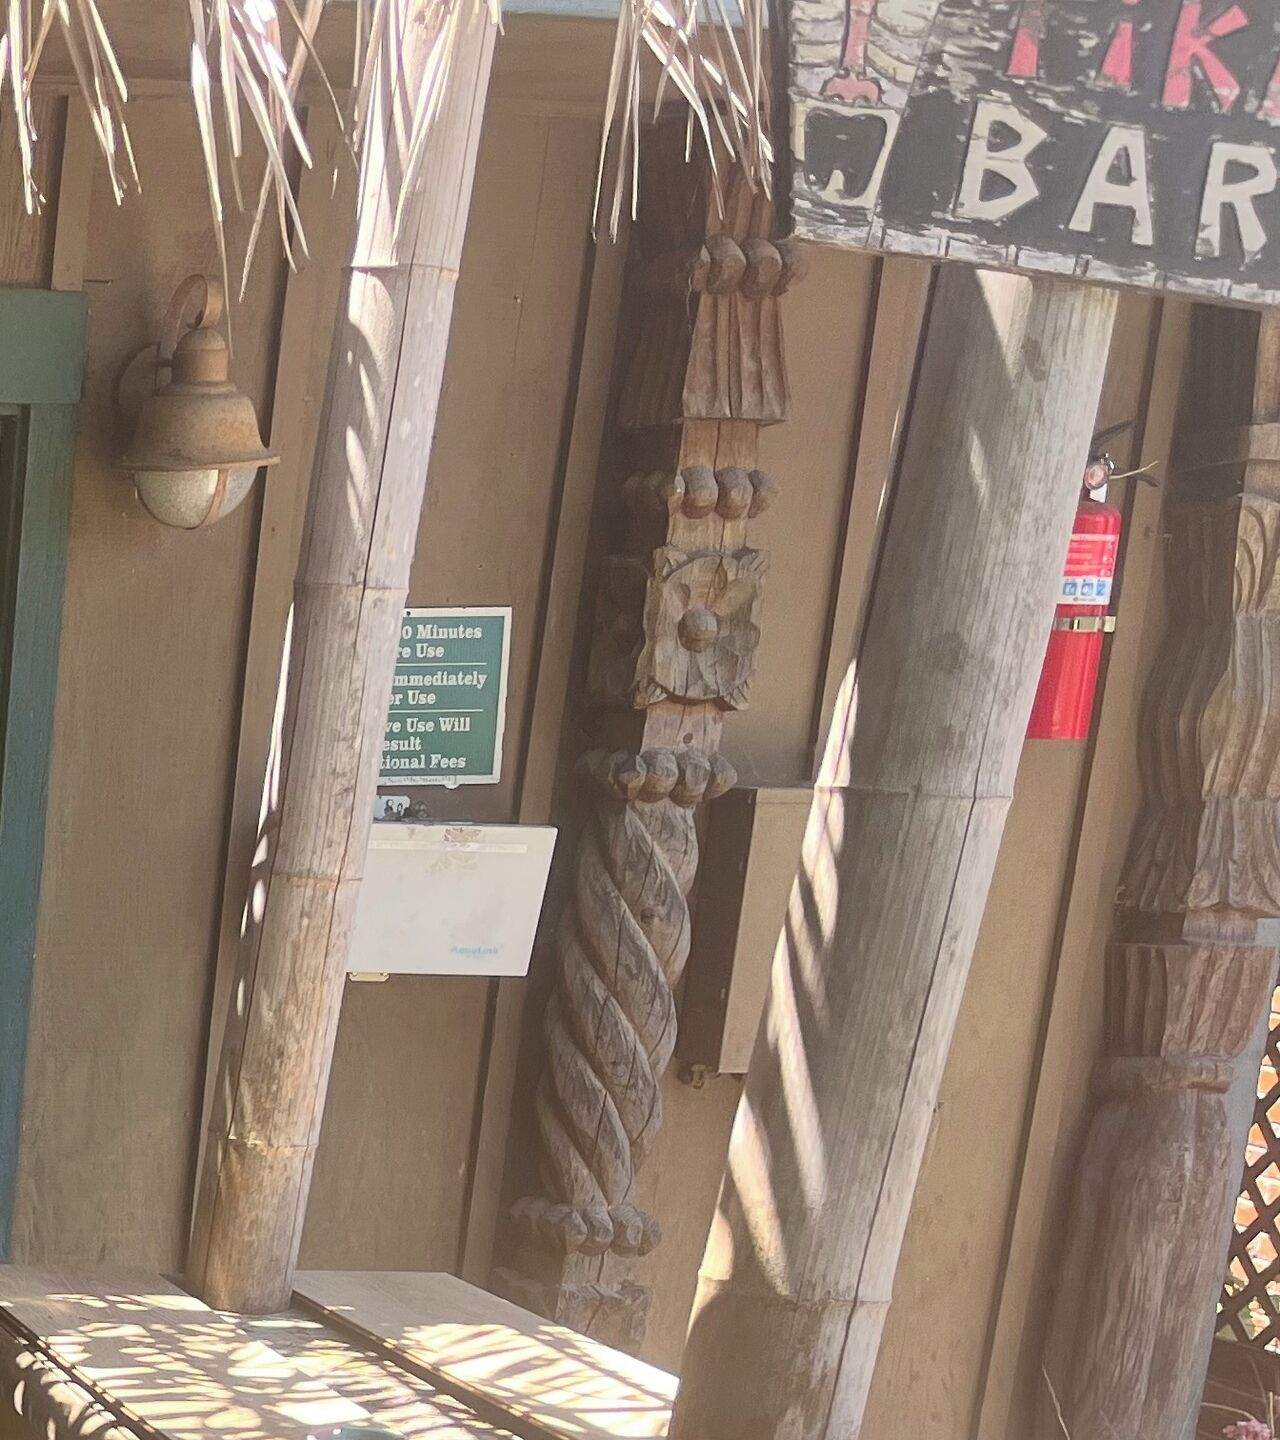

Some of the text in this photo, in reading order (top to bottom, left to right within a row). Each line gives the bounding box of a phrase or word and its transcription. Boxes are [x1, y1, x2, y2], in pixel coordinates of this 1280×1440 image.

[951, 98, 1279, 268] BAR
[416, 624, 483, 639] Minutes
[415, 643, 445, 658] Use
[393, 671, 488, 689] mmediately
[407, 690, 436, 705] Use
[406, 717, 435, 732] Use
[438, 717, 471, 732] Will
[383, 736, 422, 751] esult
[429, 753, 467, 769] Fees
